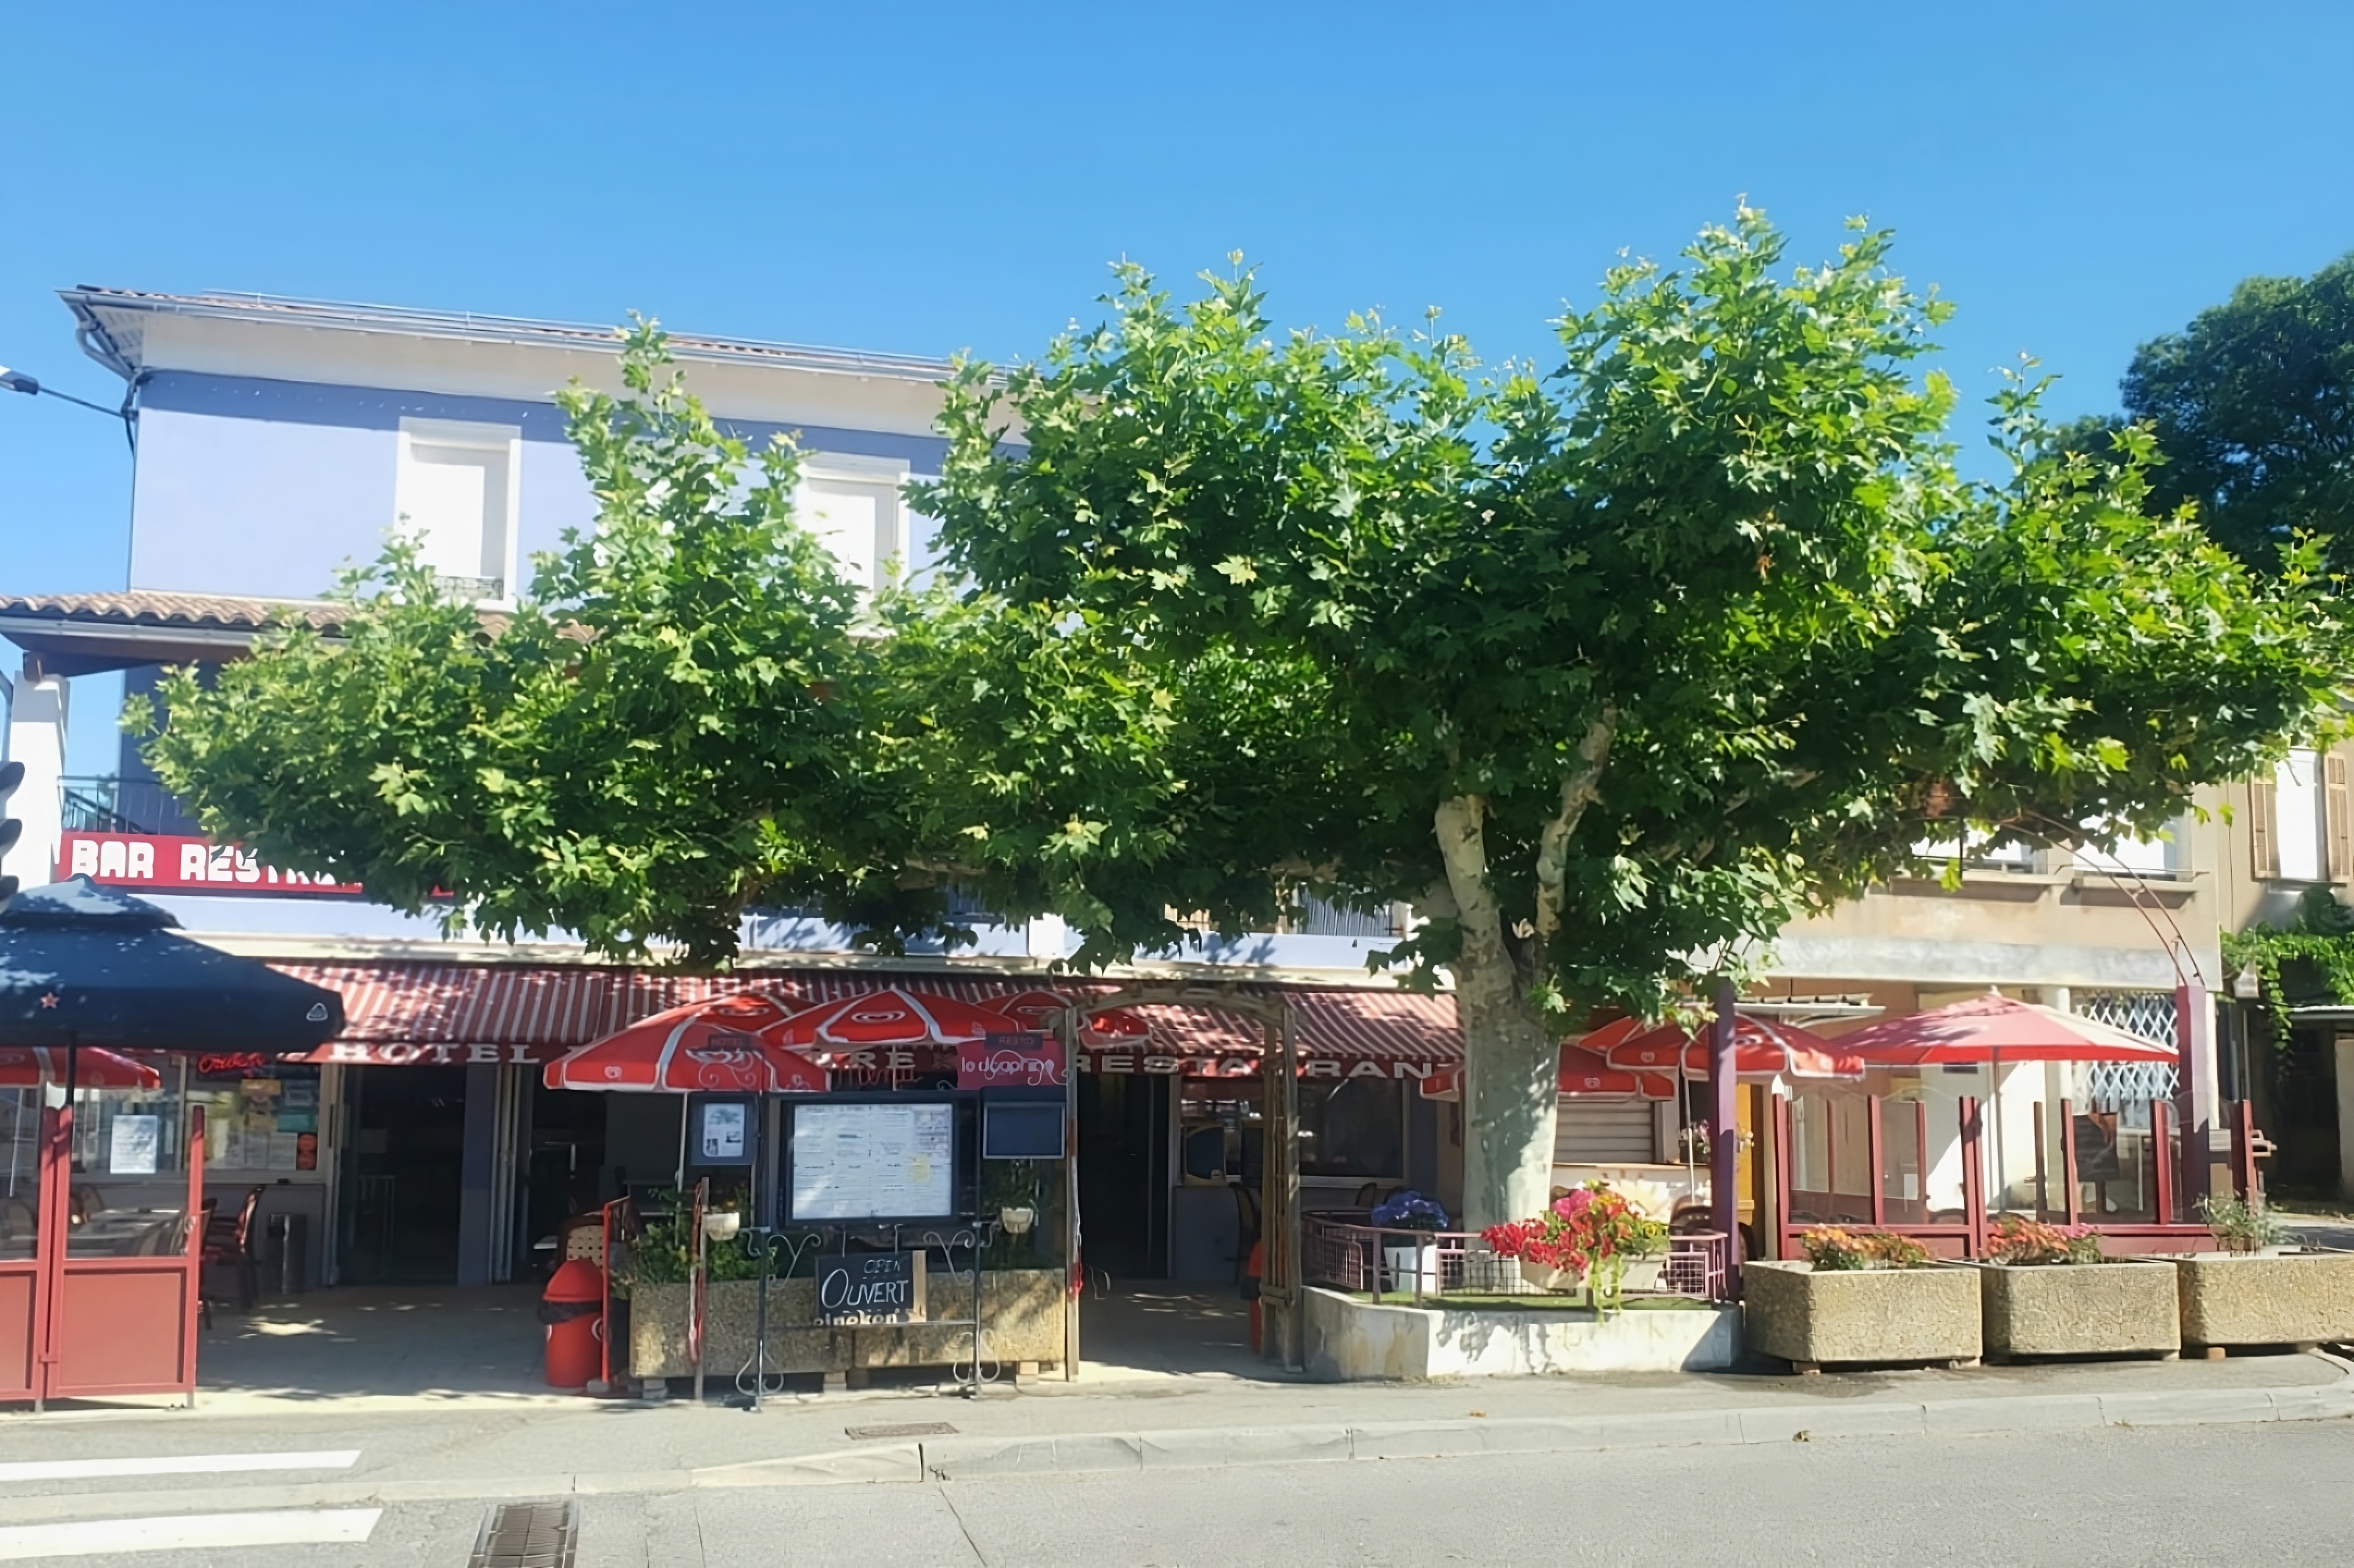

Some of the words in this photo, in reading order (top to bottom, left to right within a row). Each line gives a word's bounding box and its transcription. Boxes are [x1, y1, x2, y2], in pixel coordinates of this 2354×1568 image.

[71, 839, 154, 880] BAR
[328, 1041, 540, 1064] HOTEL
[1076, 1055, 1451, 1079] RESTARAN
